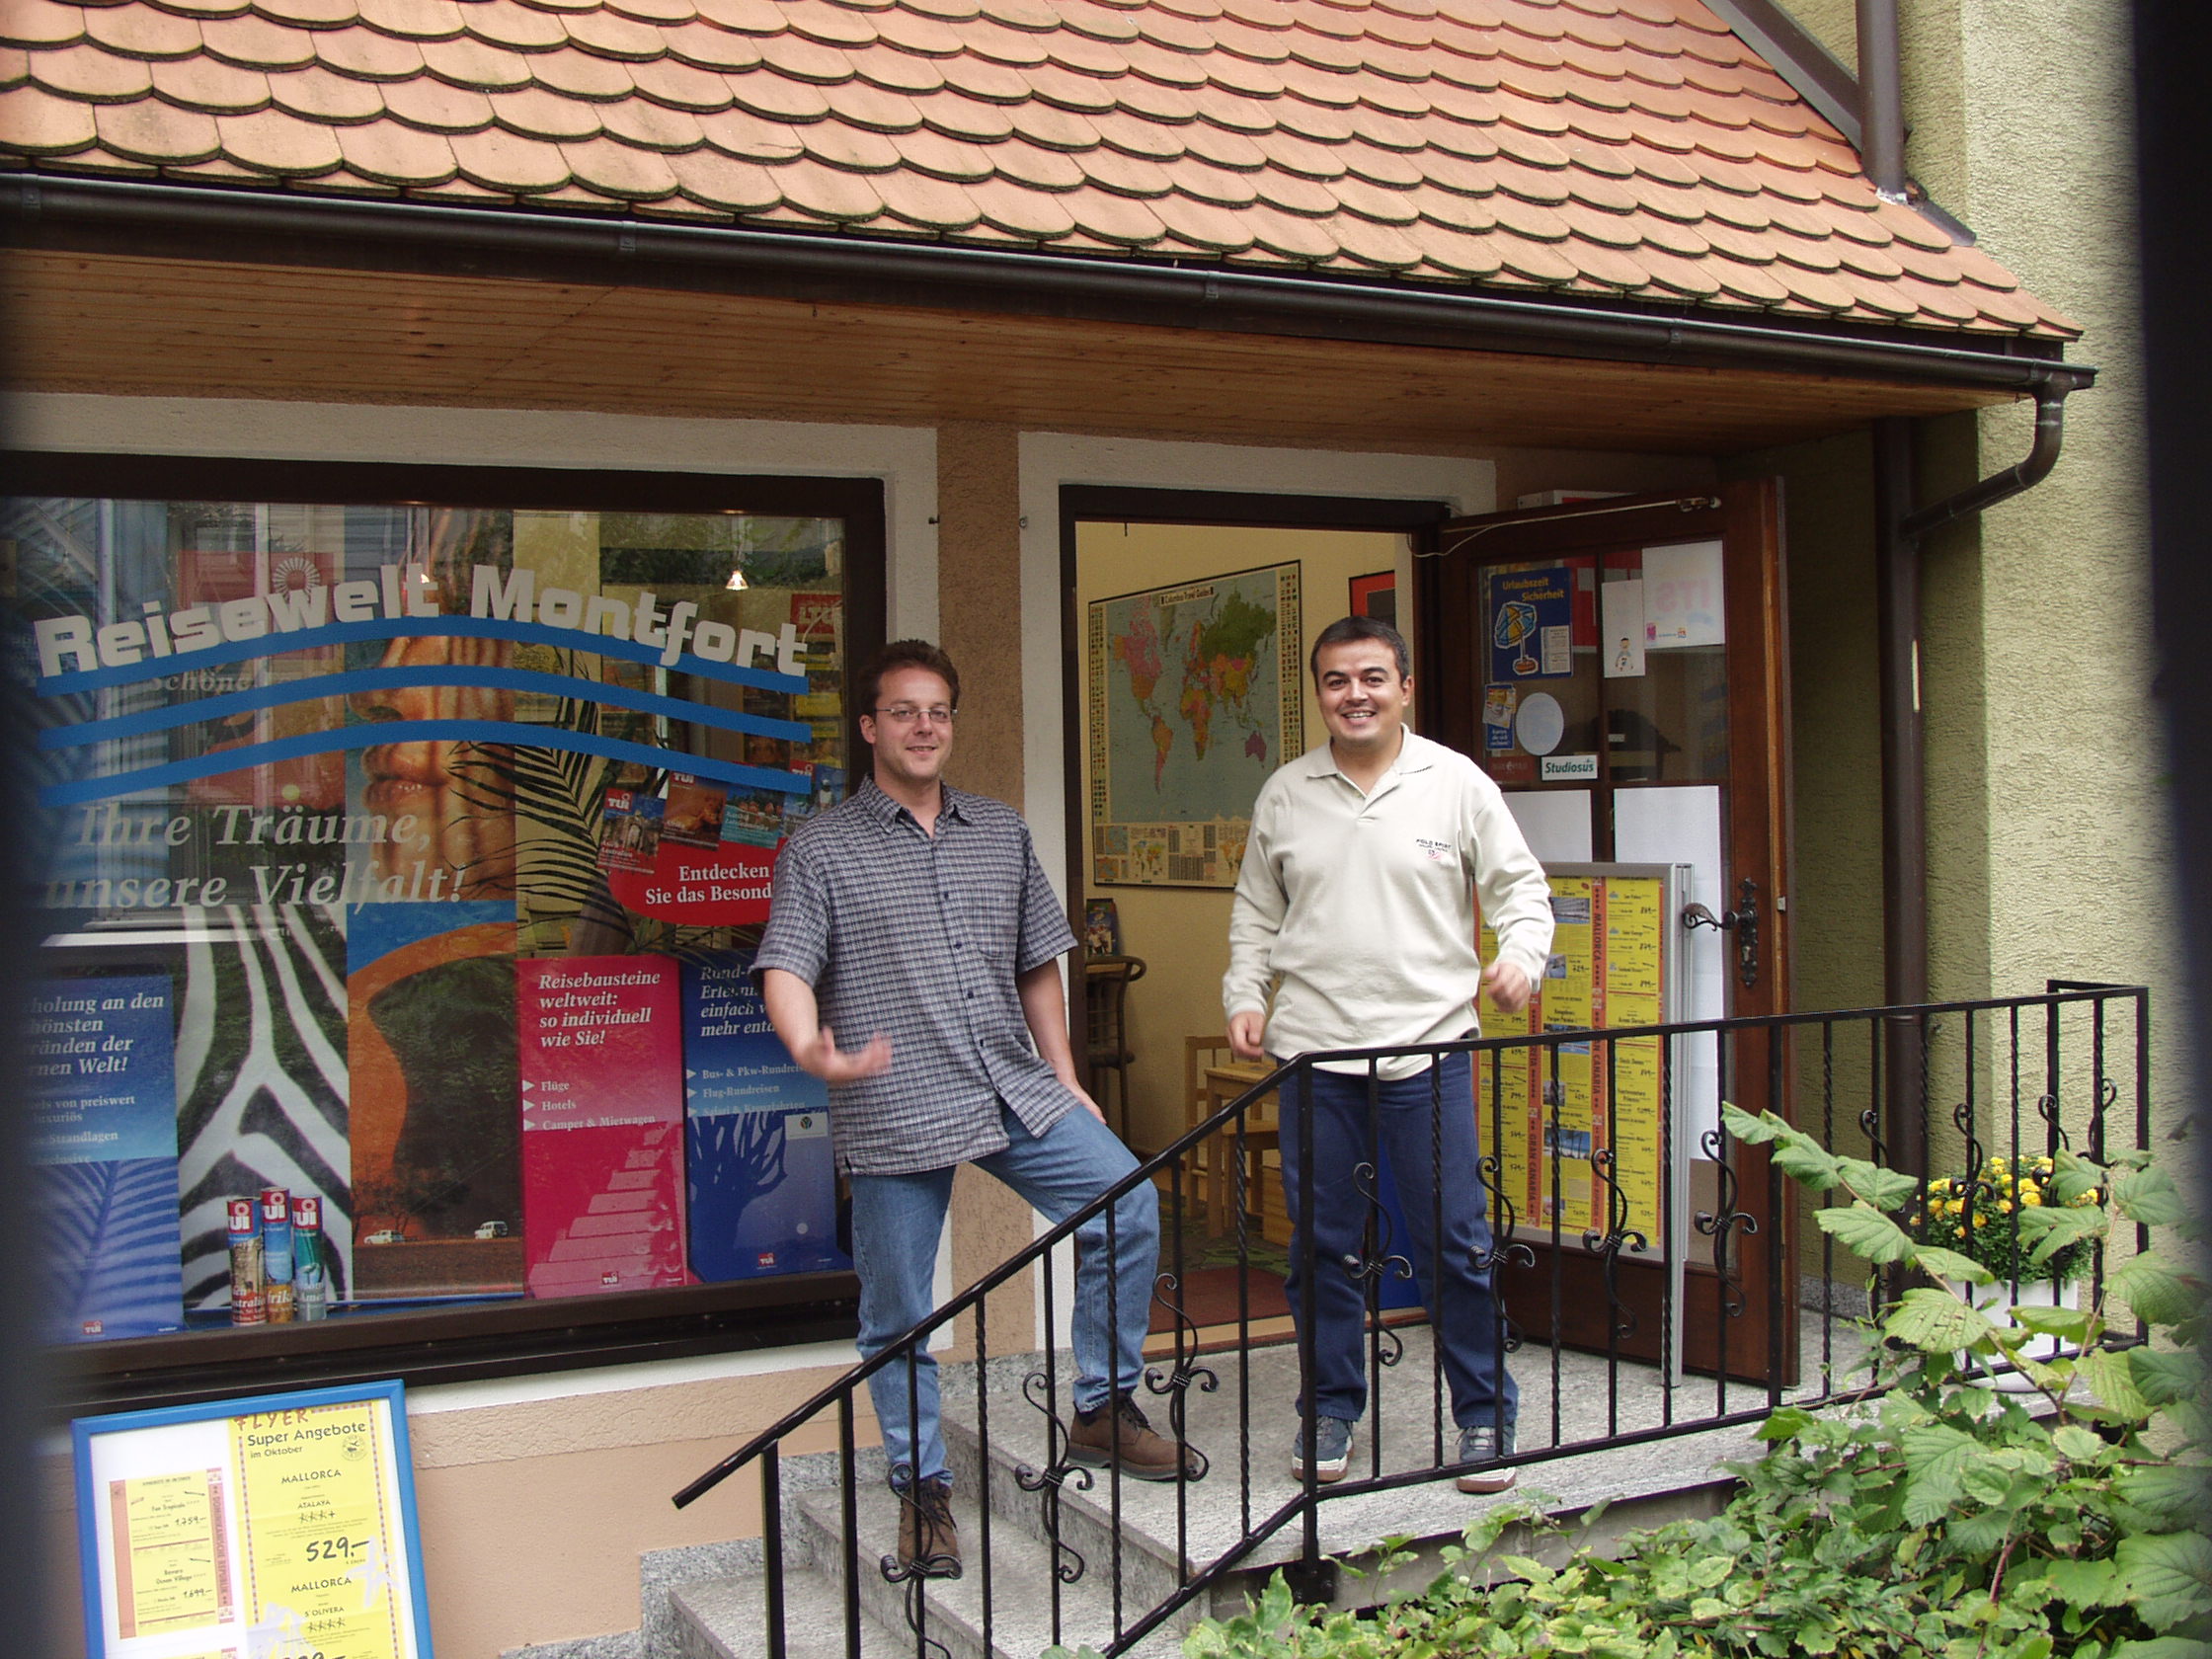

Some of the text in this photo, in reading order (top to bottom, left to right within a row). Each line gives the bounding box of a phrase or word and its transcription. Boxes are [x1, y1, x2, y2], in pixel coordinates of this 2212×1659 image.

[34, 563, 808, 677] Reisewelt Montfort
[1544, 761, 1595, 774] Studiosus
[608, 797, 629, 810] TUI
[75, 803, 432, 851] Ihre Träume,
[679, 862, 770, 882] Entdecken
[45, 863, 466, 914] unsere Vielfalt!
[646, 888, 672, 905] Sie
[676, 886, 705, 903] das
[1593, 912, 1603, 962] MALLORCA
[538, 970, 661, 989] Reisebausteine
[24, 992, 165, 1015] holung an den
[540, 990, 618, 1008] weltweit:
[540, 1007, 652, 1028] so individuell
[700, 1001, 754, 1019] einfach
[700, 1020, 741, 1037] mehr
[102, 1035, 134, 1052] der
[541, 1030, 606, 1048] wie Sie!
[79, 1057, 128, 1074] Welt!
[702, 1068, 724, 1080] Bus-
[541, 1080, 570, 1093] Flüge
[703, 1083, 780, 1098] Flug-Rundreisen
[55, 1098, 77, 1108] von
[80, 1094, 135, 1110] preiswert
[541, 1099, 577, 1111] Hotels
[542, 1114, 656, 1132] Camper & Mietwagen
[263, 1204, 286, 1220] UI
[229, 1215, 251, 1230] UI
[233, 1408, 309, 1431] FLYER
[247, 1422, 366, 1448] Super Angebote
[250, 1446, 303, 1460] im Oktober
[280, 1468, 342, 1484] MALLORCA
[290, 1576, 353, 1593] MALLORCA
